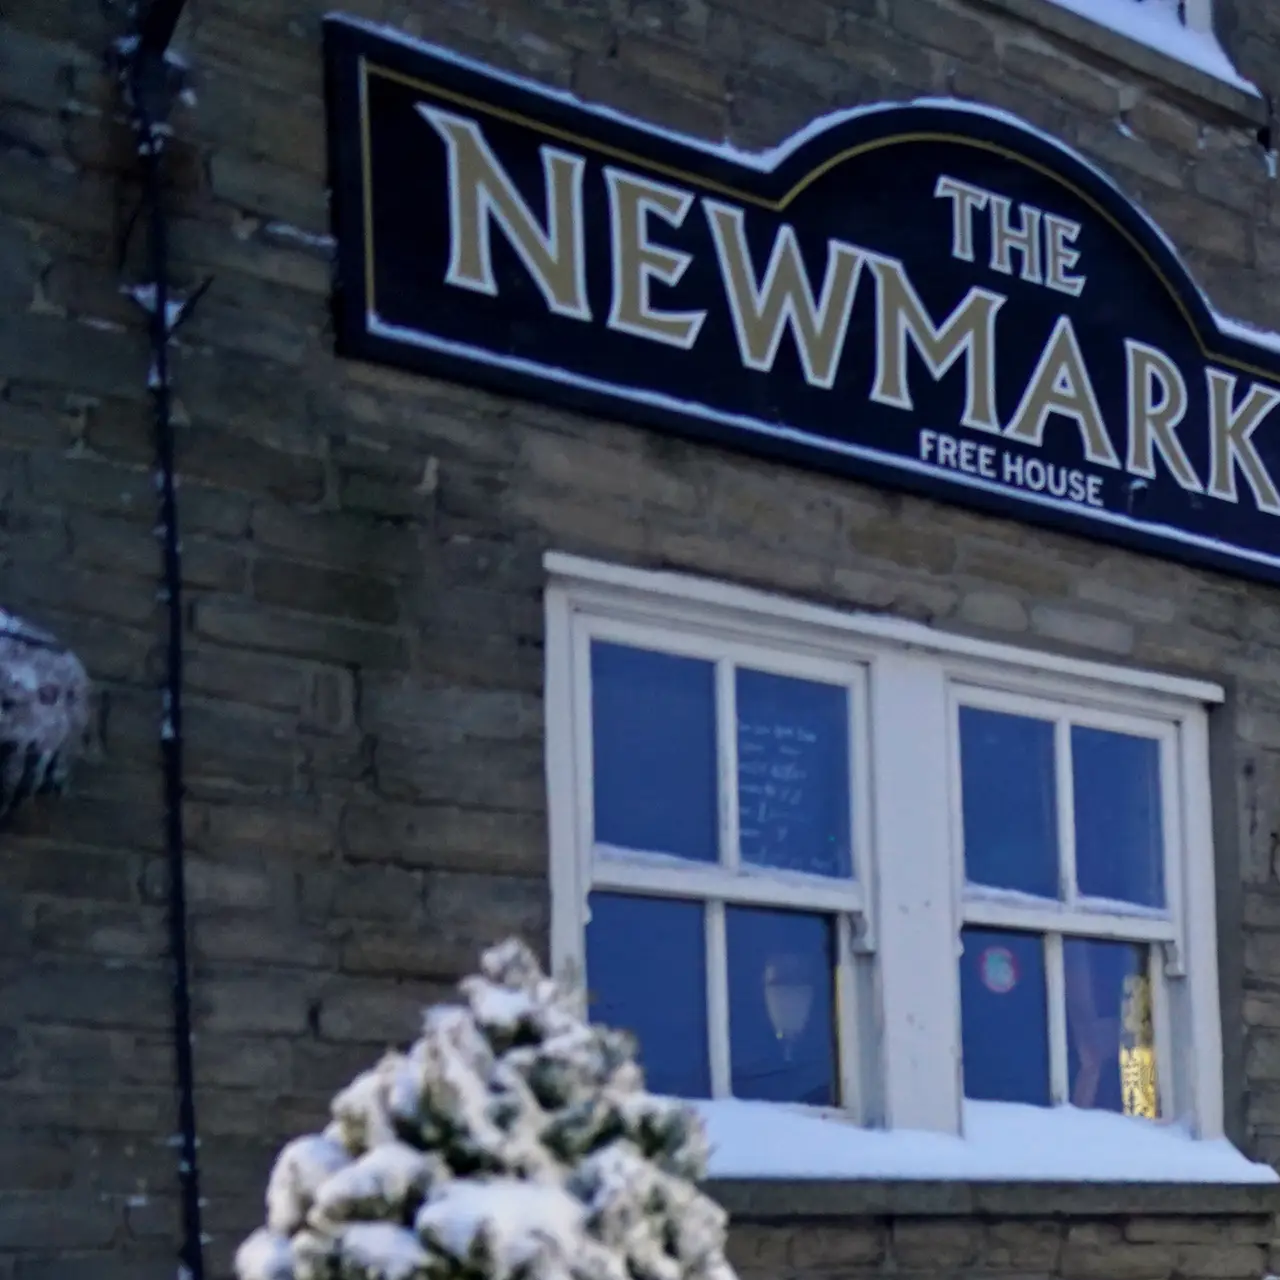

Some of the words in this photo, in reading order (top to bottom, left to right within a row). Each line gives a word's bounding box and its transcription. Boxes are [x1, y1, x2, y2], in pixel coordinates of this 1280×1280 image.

[934, 175, 1086, 297] THE
[919, 429, 996, 478] FREE
[1002, 451, 1104, 507] HOUSE
